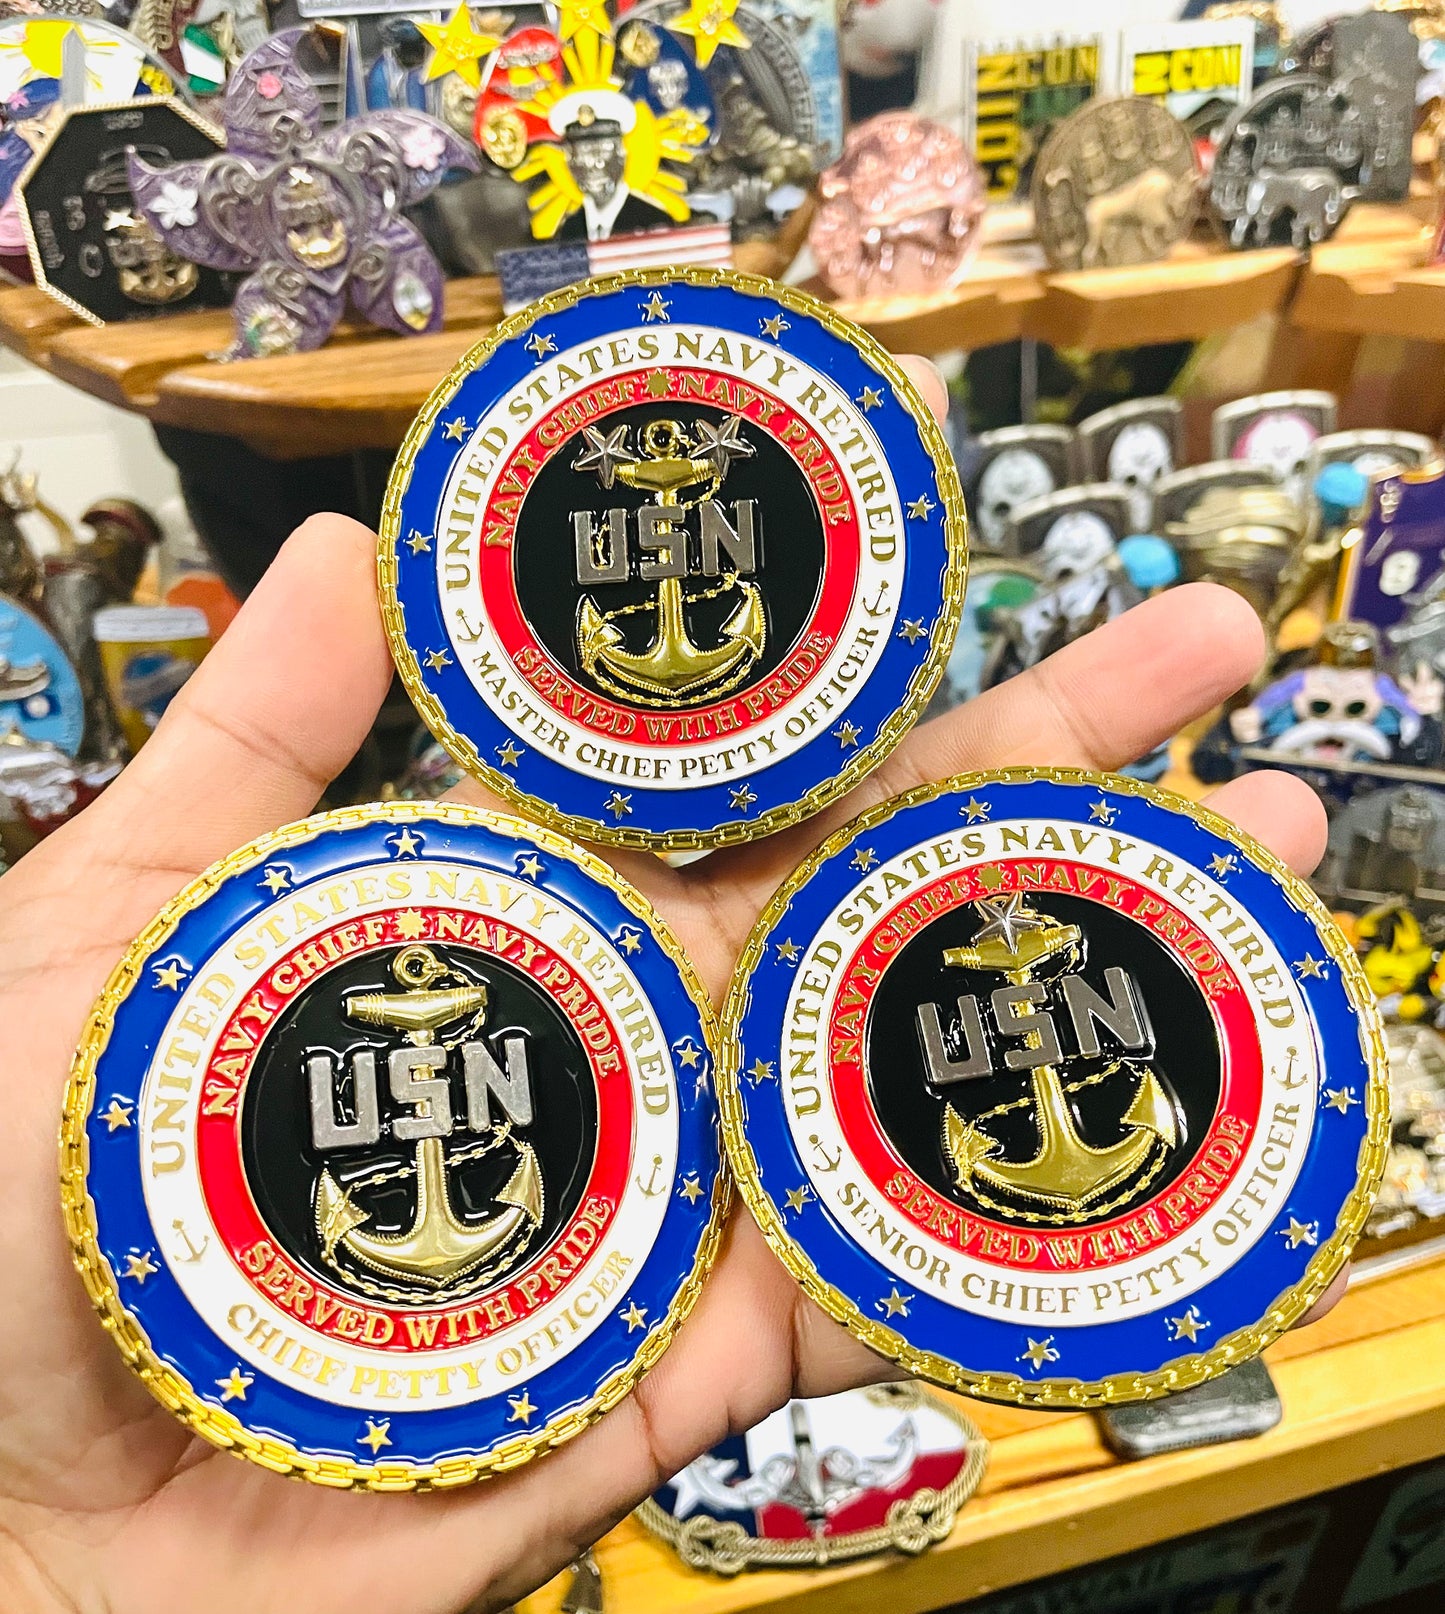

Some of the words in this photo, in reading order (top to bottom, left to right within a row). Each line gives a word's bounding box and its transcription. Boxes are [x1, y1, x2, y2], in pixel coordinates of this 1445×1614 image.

[445, 426, 508, 590] UNITED
[509, 335, 659, 424] STATES
[675, 333, 797, 386] NAVY
[798, 382, 897, 561] RETIRED
[487, 450, 540, 547] NAVY
[538, 377, 636, 448] CHIEF
[680, 379, 785, 424] NAVY
[784, 422, 852, 525] PRIDE
[573, 499, 758, 583] USN
[472, 651, 570, 754] MASTER
[575, 743, 670, 779] CHIEF
[681, 732, 777, 778] PETTY
[784, 627, 878, 737] OFFICER
[514, 647, 636, 737] SERVED
[642, 710, 746, 743] WITH
[749, 632, 831, 720] PRIDE
[437, 916, 546, 970] NAVY
[546, 961, 621, 1077] PRIDE
[791, 940, 840, 1118] UNITED
[839, 834, 985, 935] STATES
[1001, 825, 1136, 862] NAVY
[1142, 853, 1295, 1030] RETIRED
[831, 968, 879, 1064] NAVY
[873, 871, 970, 953] CHIEF
[1016, 866, 1123, 903] NAVY
[1134, 893, 1229, 999] PRIDE
[153, 975, 235, 1177] UNITED
[236, 872, 412, 967] STATES
[427, 870, 559, 929] NAVY
[559, 922, 668, 1116] RETIRED
[203, 998, 276, 1116] NAVY
[273, 918, 383, 992] CHIEF
[918, 965, 1154, 1085] USN
[305, 1038, 536, 1149] USN
[837, 1182, 949, 1287] SENIOR
[961, 1272, 1079, 1313] CHIEF
[1090, 1237, 1210, 1312] PETTY
[1212, 1103, 1300, 1245] OFFICER
[885, 1171, 1038, 1265] SERVED
[1045, 1217, 1163, 1267] WITH
[1163, 1115, 1251, 1234] PRIDE
[229, 1303, 347, 1389] CHIEF
[352, 1358, 485, 1399] PETTY
[496, 1253, 635, 1375] OFFICER
[241, 1240, 393, 1345] SERVED
[403, 1300, 513, 1347] WITH
[513, 1198, 613, 1325] PRIDE
